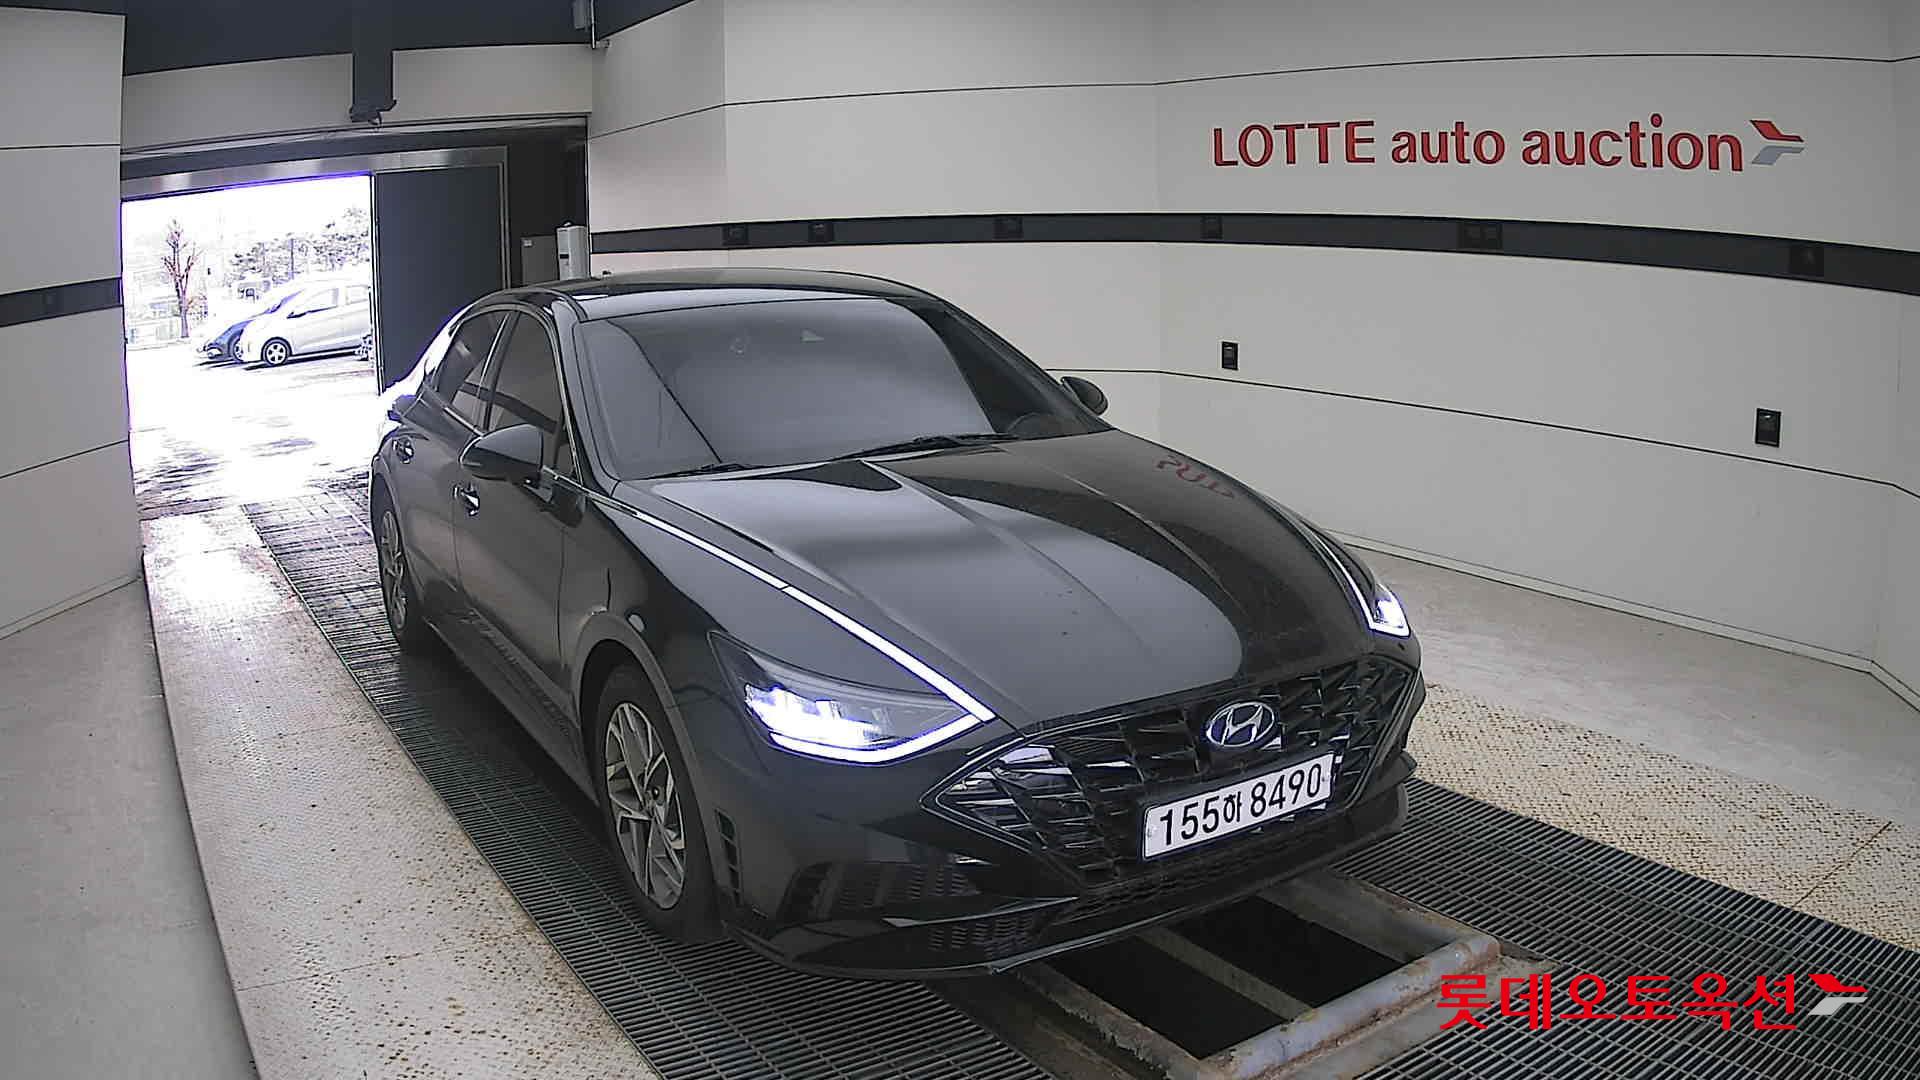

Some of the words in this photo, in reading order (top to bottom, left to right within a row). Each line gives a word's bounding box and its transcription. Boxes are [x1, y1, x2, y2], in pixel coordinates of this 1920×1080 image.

[1212, 120, 1376, 167] LOTTE
[1391, 121, 1505, 165] auto
[1521, 113, 1743, 173] auction
[1160, 791, 1242, 845] 155하
[1250, 763, 1322, 818] 8490
